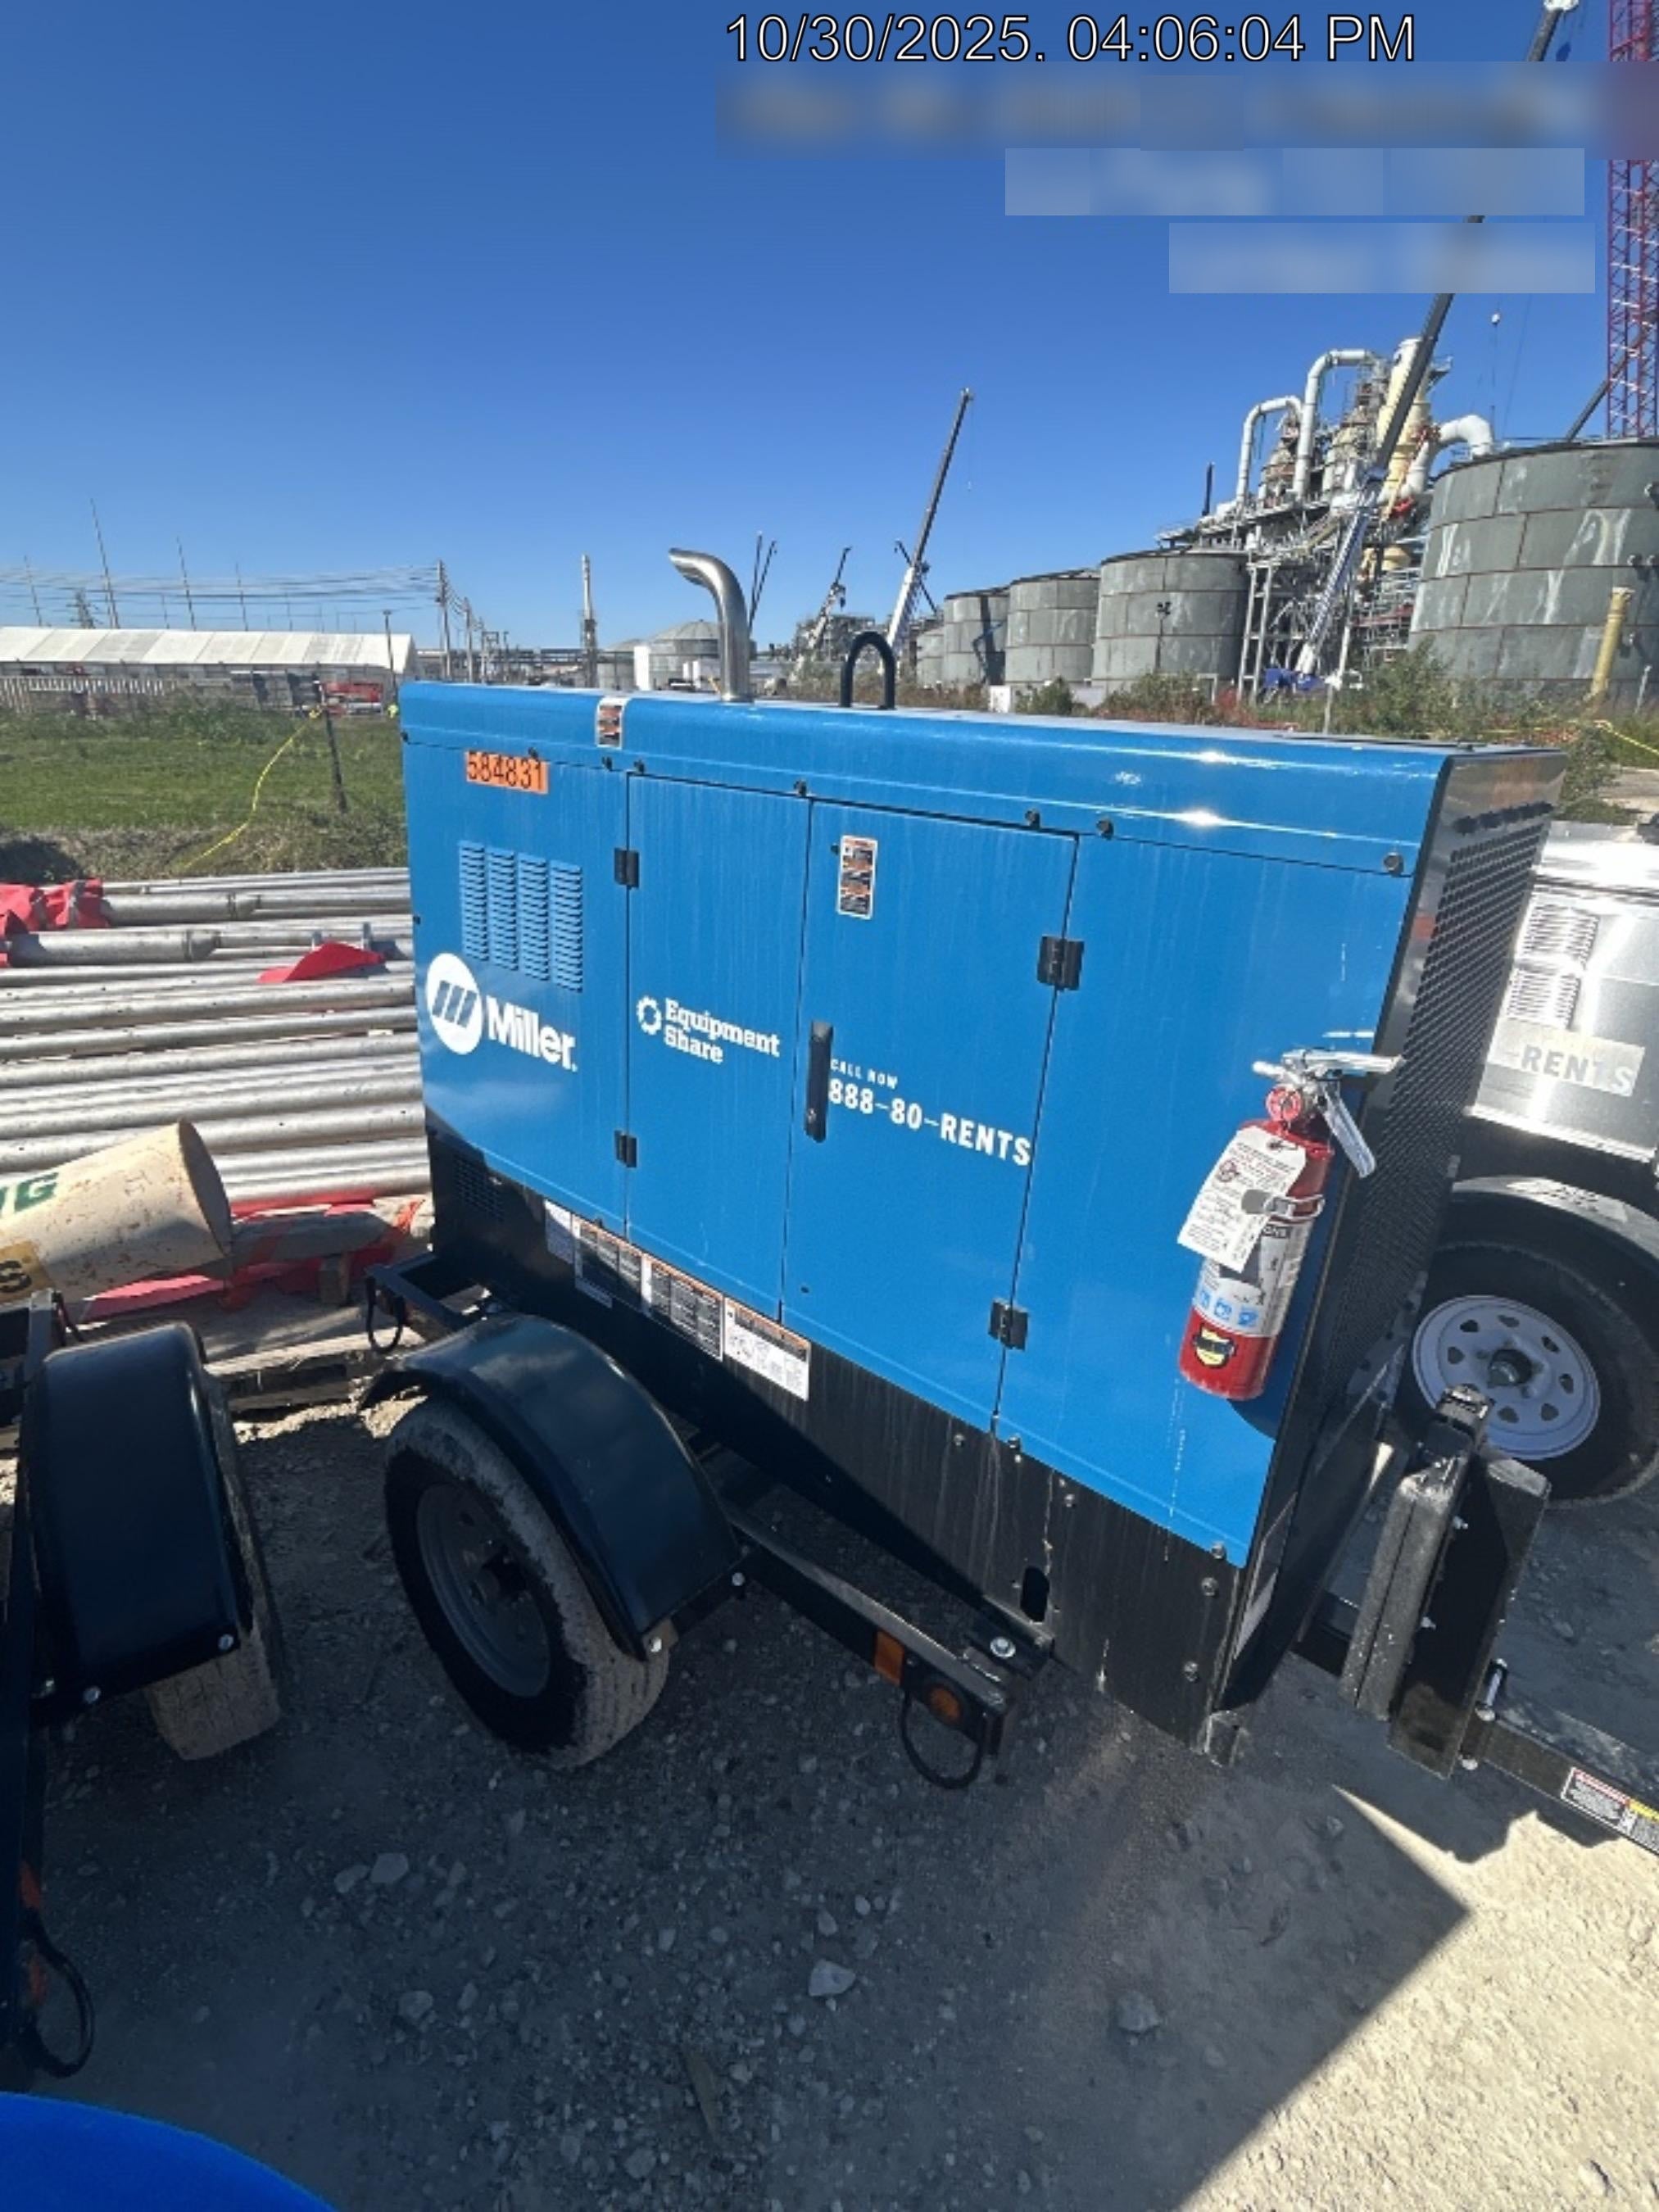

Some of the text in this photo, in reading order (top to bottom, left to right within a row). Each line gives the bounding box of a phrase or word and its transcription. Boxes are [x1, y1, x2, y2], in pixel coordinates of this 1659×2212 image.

[468, 750, 542, 791] 584831
[664, 1024, 724, 1064] Share
[665, 997, 780, 1058] Equipment
[831, 1058, 899, 1090] CALL NOW
[828, 1077, 1031, 1167] 888-80-RENTS
